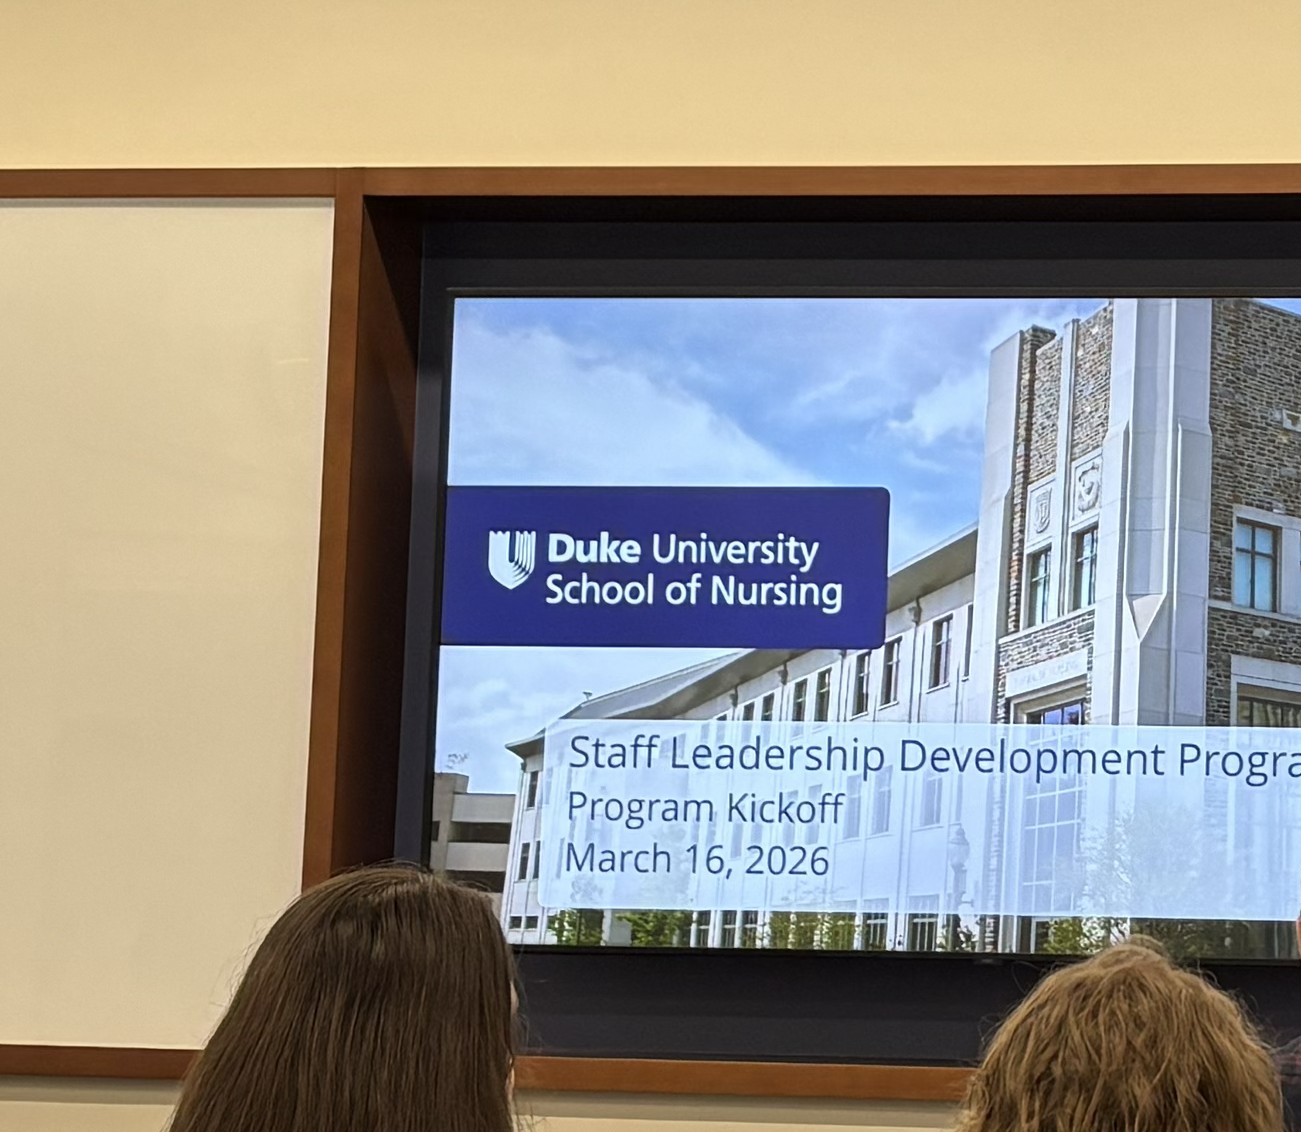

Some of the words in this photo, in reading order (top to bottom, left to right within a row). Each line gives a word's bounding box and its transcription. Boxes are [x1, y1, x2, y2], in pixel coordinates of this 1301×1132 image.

[547, 531, 642, 564] Duke
[652, 532, 820, 573] University
[545, 572, 654, 605] School
[665, 573, 702, 605] of
[711, 574, 843, 614] Nursing
[568, 734, 661, 769] Staff
[670, 735, 886, 779] Leadership
[899, 738, 1166, 784] Development
[567, 791, 715, 830] Program
[727, 791, 847, 825] Kickoff
[565, 842, 672, 874] March
[685, 843, 733, 880] 16,
[744, 845, 830, 876] 2026
